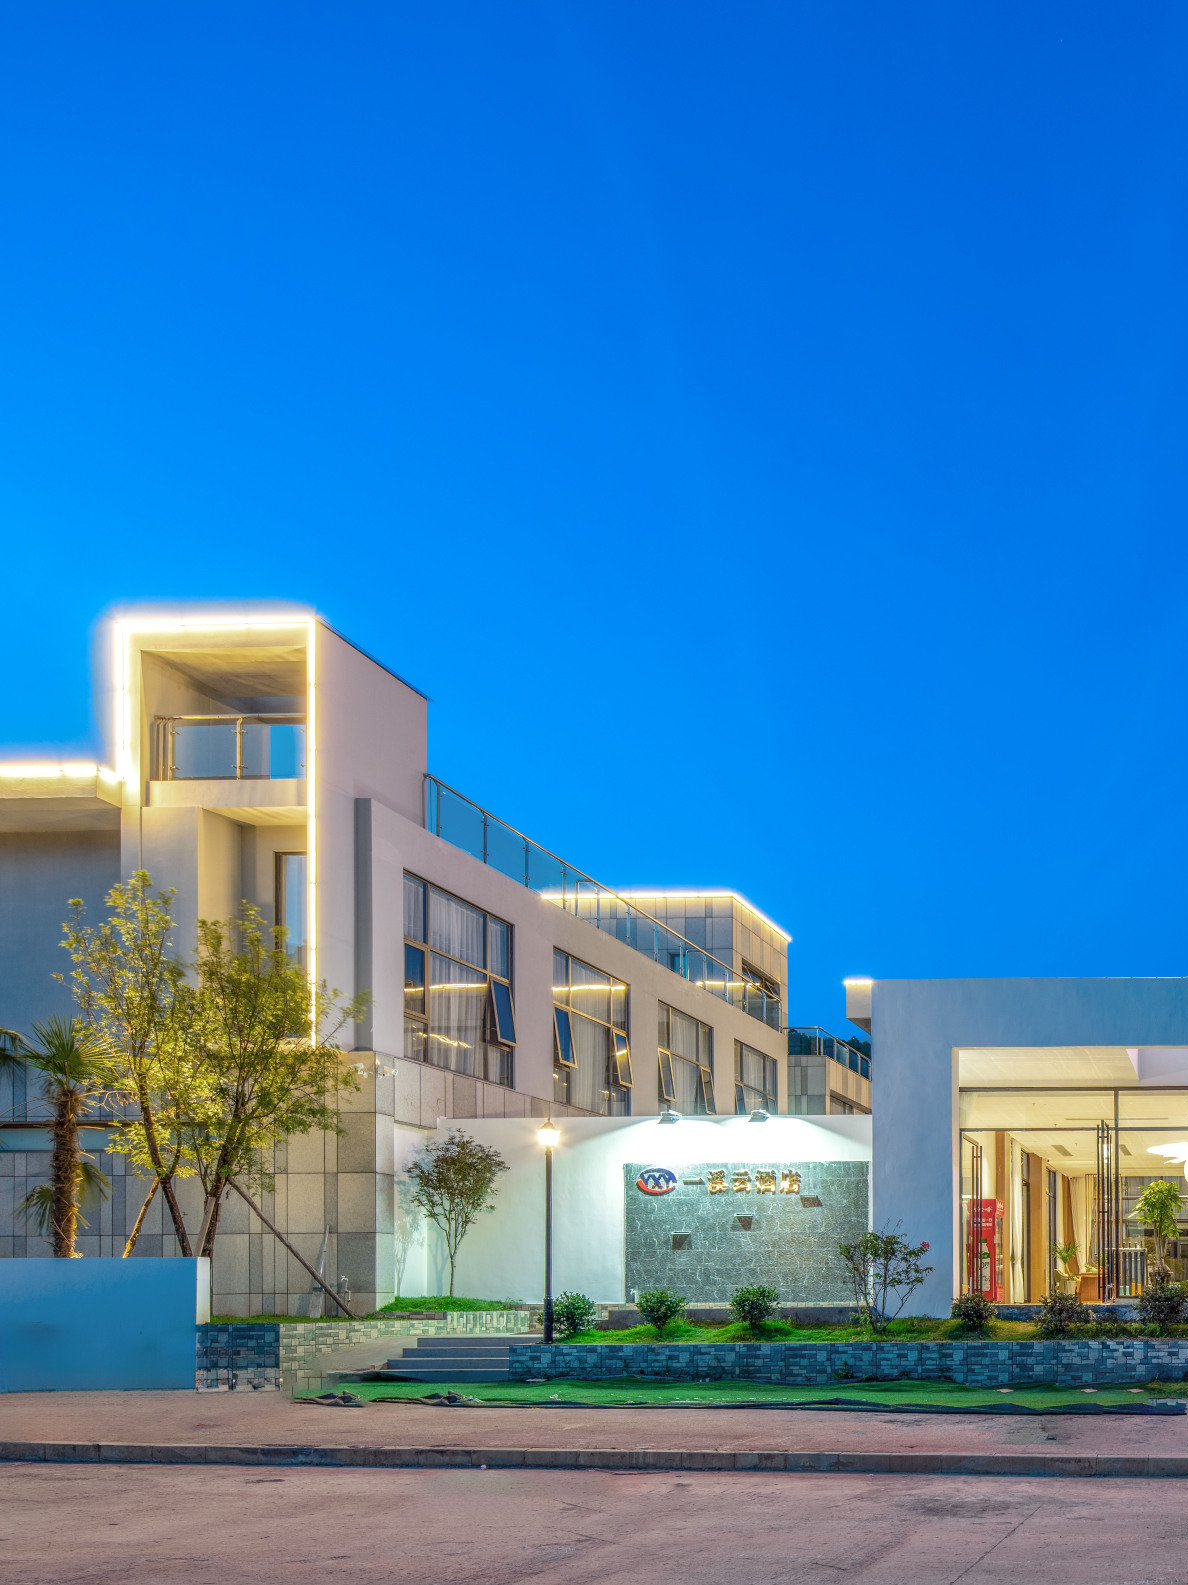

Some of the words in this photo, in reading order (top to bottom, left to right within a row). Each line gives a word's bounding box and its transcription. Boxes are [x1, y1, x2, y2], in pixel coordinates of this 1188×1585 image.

[640, 1174, 672, 1188] YXY
[682, 1169, 801, 1195] 一溪云酒店
